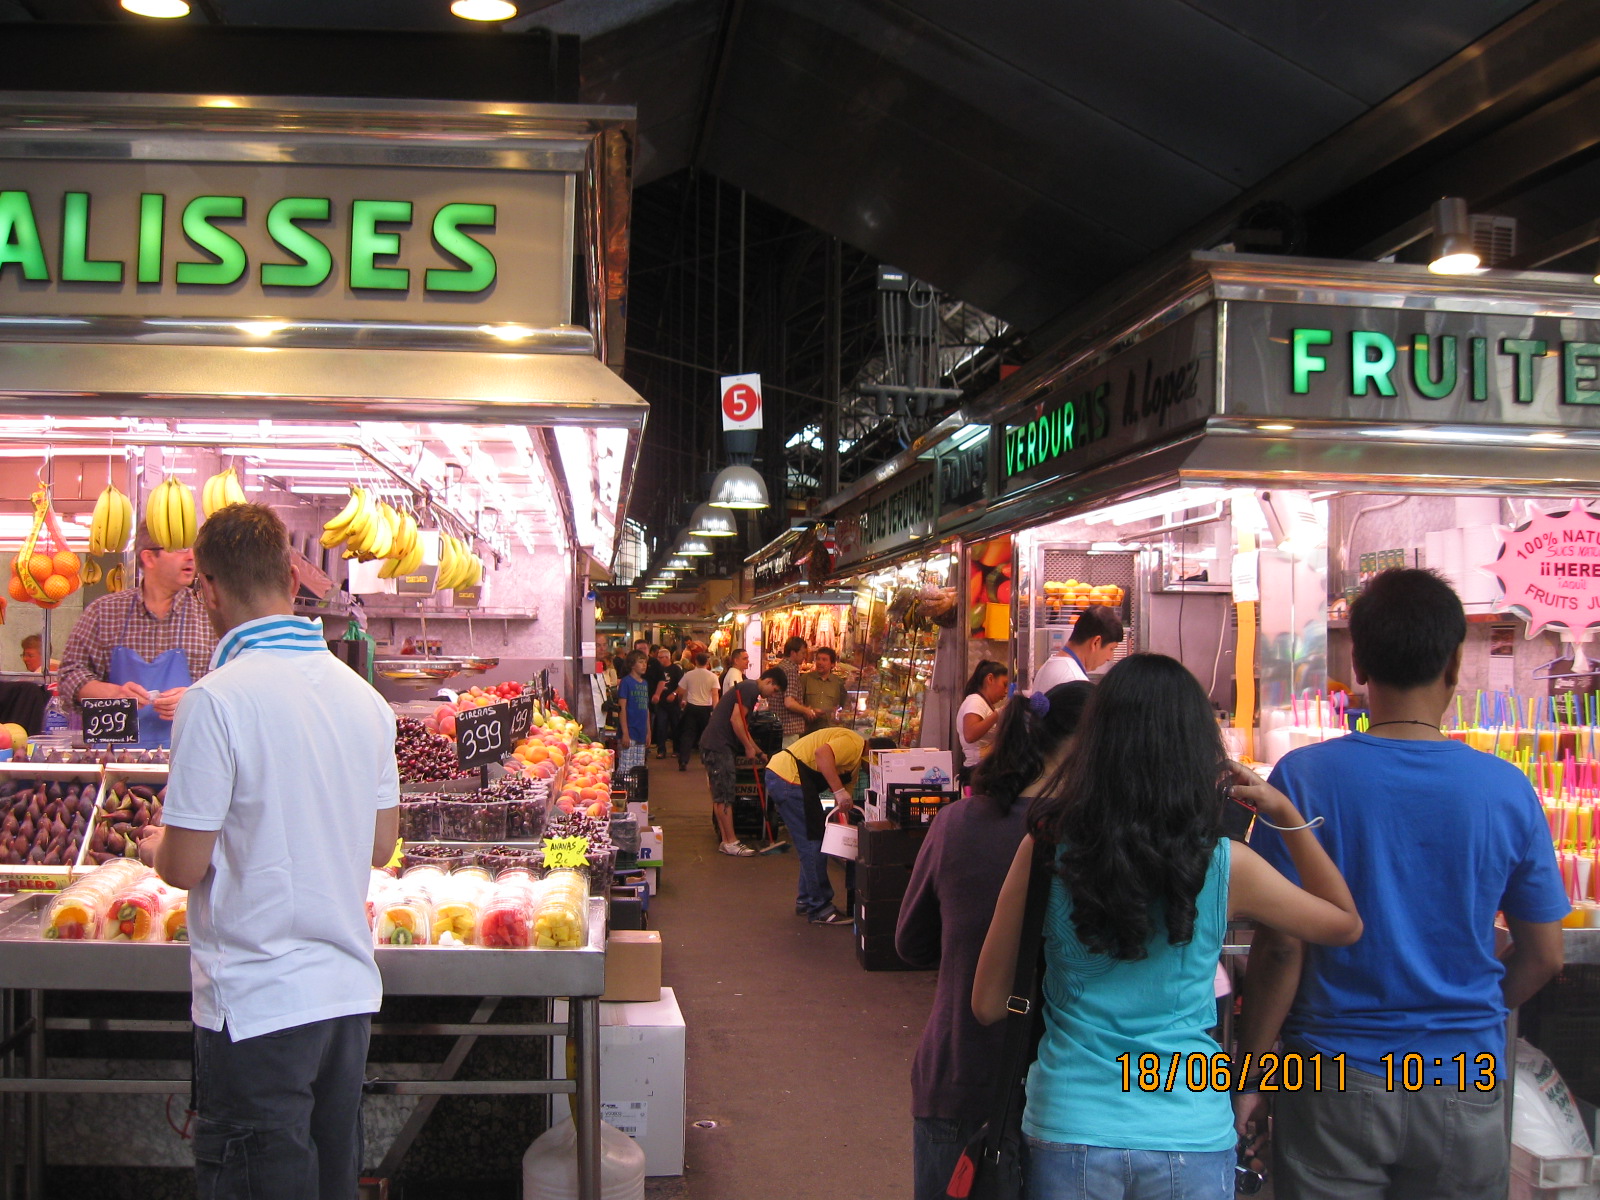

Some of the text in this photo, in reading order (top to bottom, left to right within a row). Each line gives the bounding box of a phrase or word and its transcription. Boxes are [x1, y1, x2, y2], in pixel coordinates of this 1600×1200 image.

[0, 191, 498, 294] ALISSES
[1293, 328, 1600, 405] FRUITE
[733, 389, 748, 416] 5
[1005, 381, 1111, 477] VERDURAS
[1517, 531, 1558, 559] 100%
[1525, 583, 1578, 610] FRUITS
[550, 841, 576, 852] ANANAS
